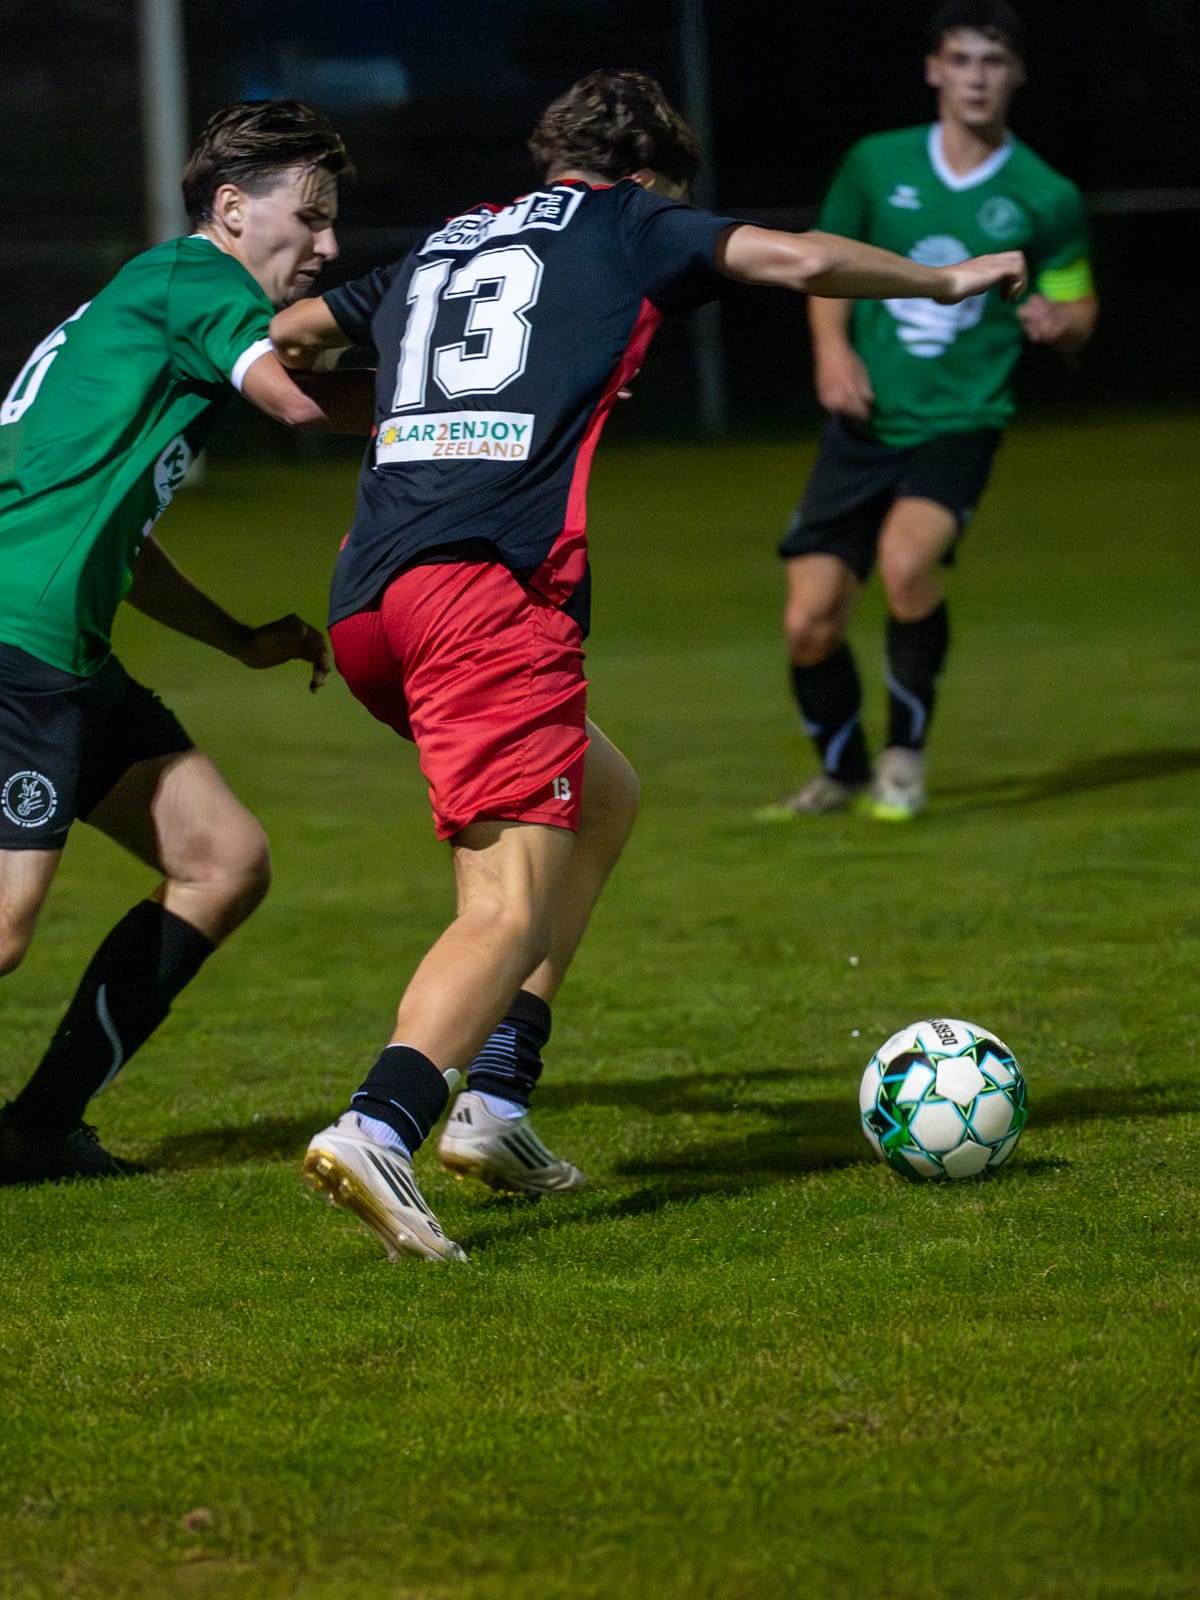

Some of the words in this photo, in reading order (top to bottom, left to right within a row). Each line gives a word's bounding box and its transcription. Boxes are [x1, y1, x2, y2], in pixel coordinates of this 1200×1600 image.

[391, 245, 544, 412] 13
[432, 441, 526, 459] ZEELAND
[552, 776, 571, 801] 13
